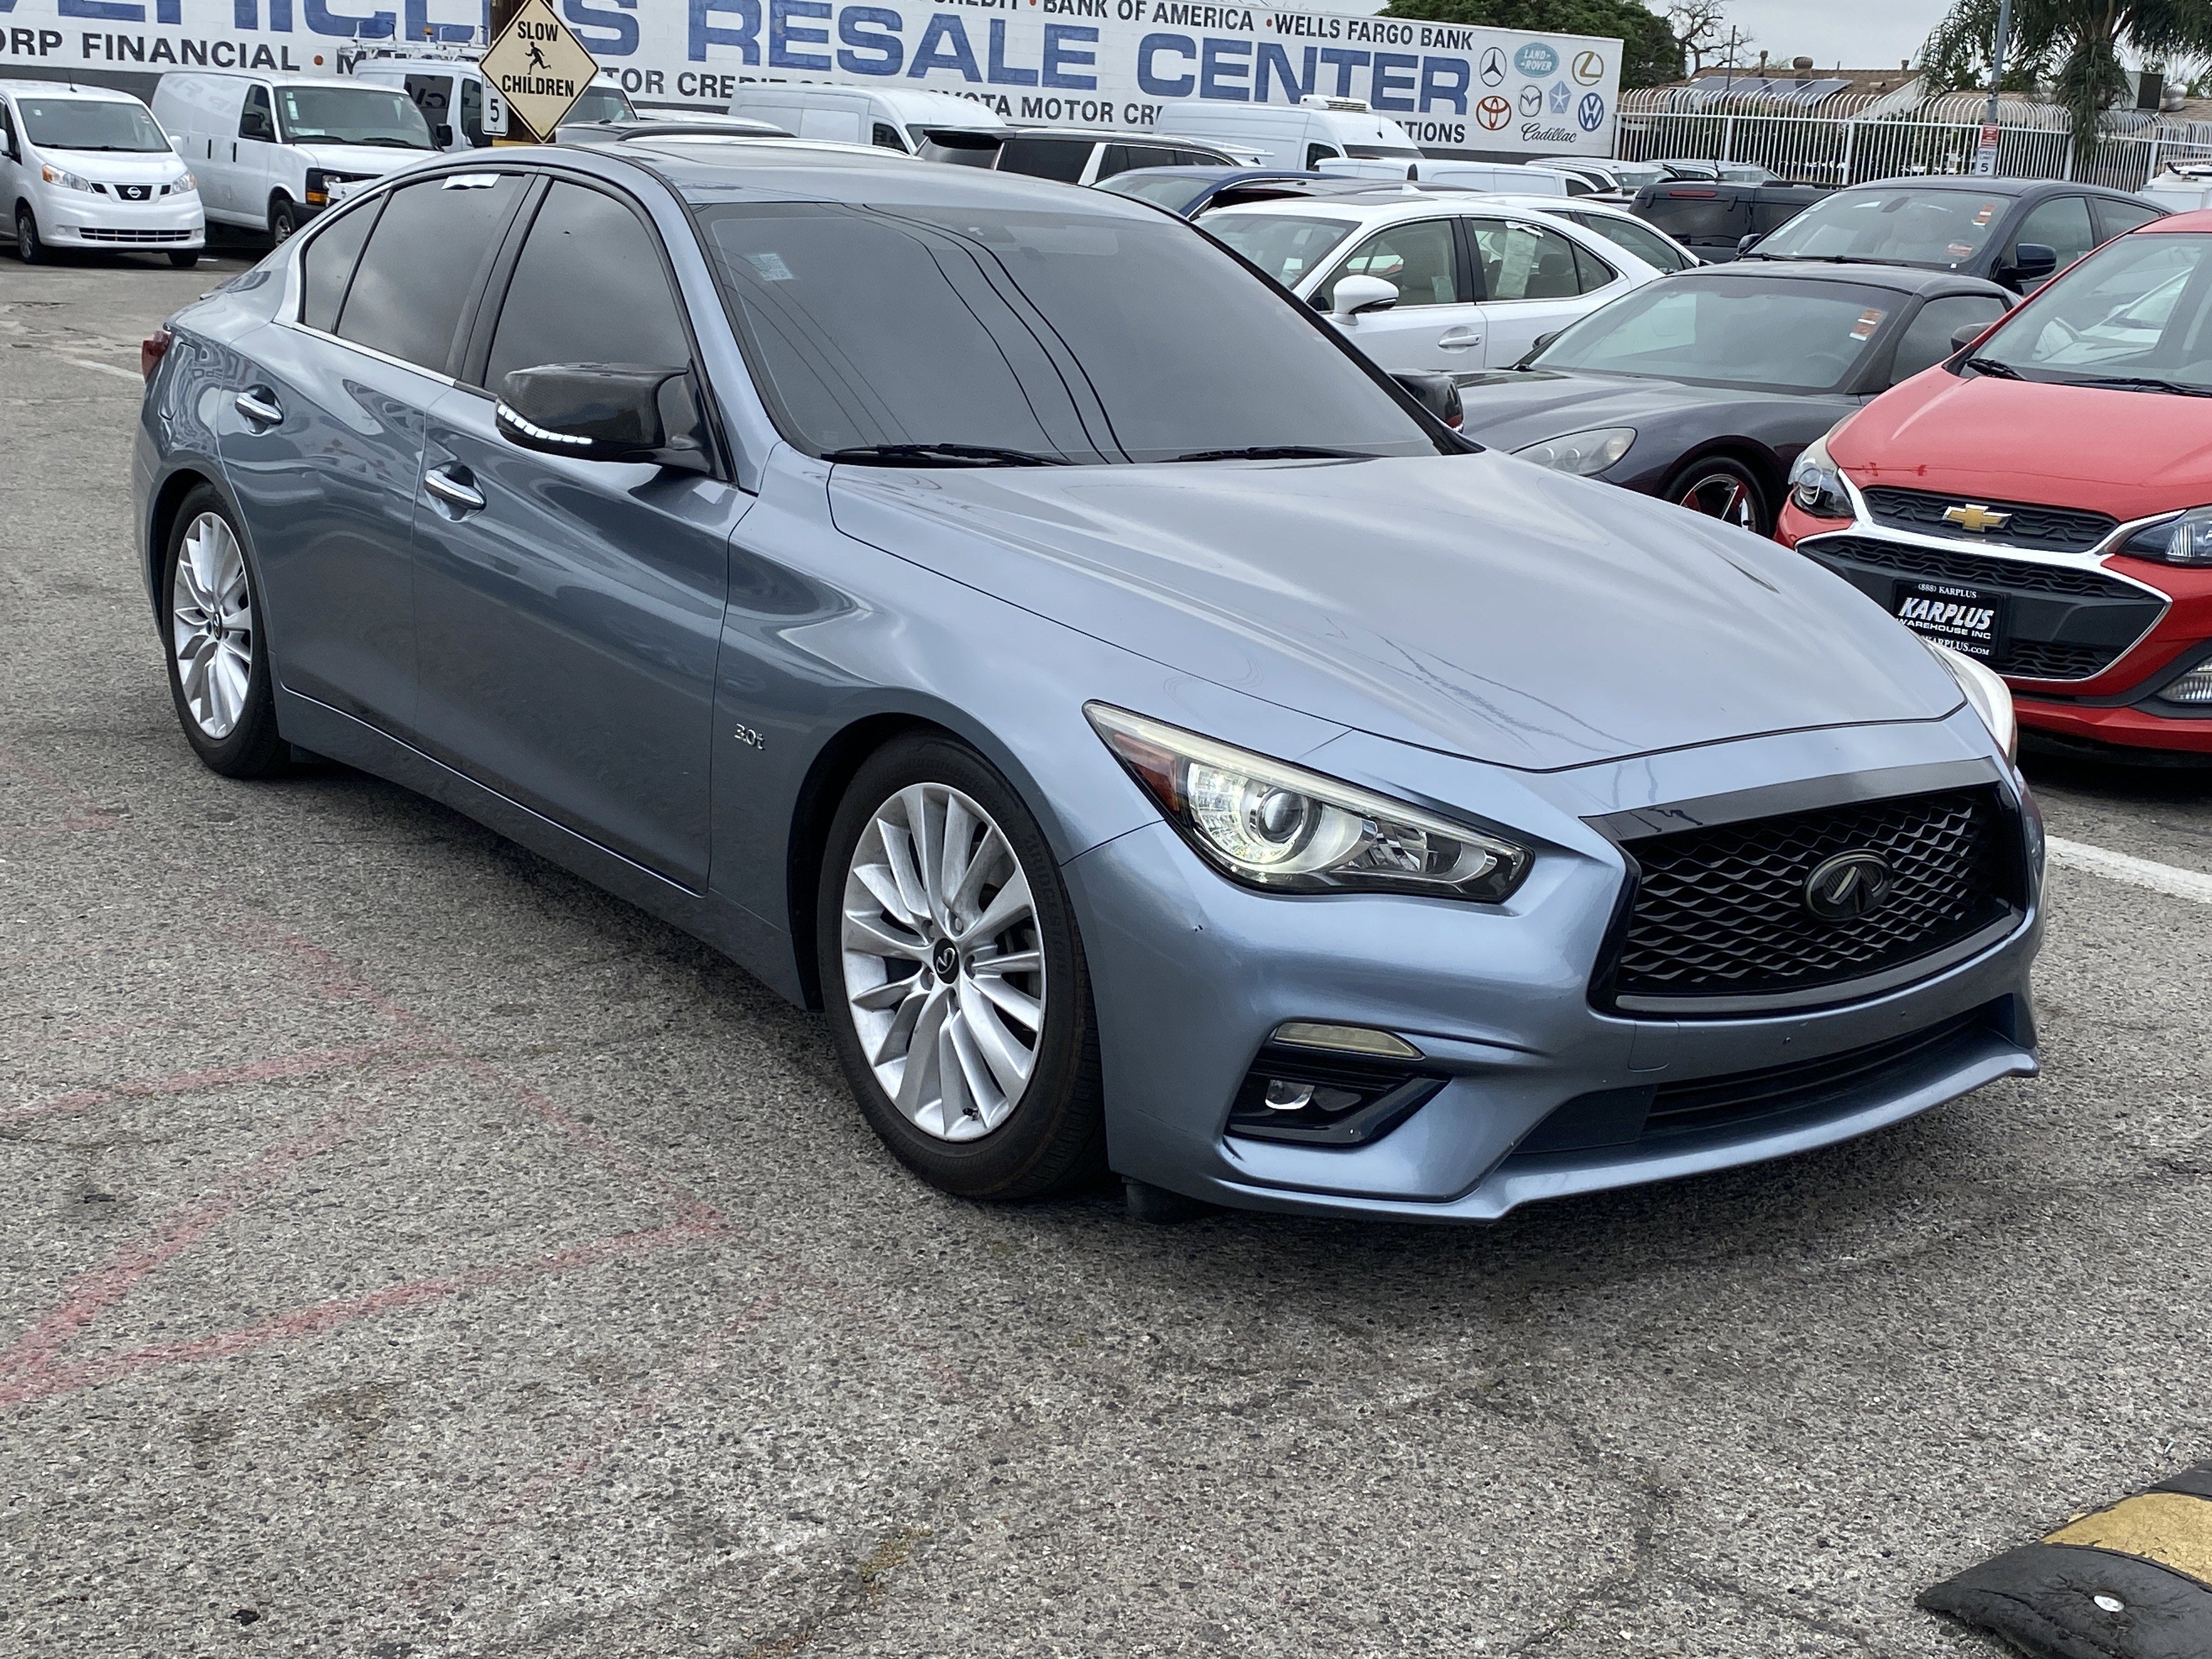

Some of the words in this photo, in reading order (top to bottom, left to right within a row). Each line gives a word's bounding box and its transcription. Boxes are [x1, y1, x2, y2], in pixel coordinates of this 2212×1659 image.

[517, 21, 558, 41] SLOW
[1043, 0, 1108, 18] BANK
[1118, 0, 1147, 21] OF
[1152, 3, 1255, 31] AMERICA
[1274, 14, 1341, 39] WELLS
[1347, 21, 1414, 44] FARGO
[1420, 28, 1474, 50] BANK
[0, 27, 63, 56] RP
[82, 32, 301, 72] FINANCIAL
[687, 0, 1099, 90] RESALE
[1137, 33, 1470, 115] CENTER
[502, 75, 574, 98] CHILDREN
[678, 72, 787, 99] CRE
[490, 99, 499, 122] 5
[1021, 97, 1114, 122] MOTOR
[1395, 121, 1465, 144] TIONS
[1521, 122, 1577, 143] Cadillac
[1980, 163, 1988, 172] 5
[1918, 584, 1937, 592] (888)
[1939, 586, 1977, 599] KARPLUS
[1898, 597, 1995, 630] KARPLUS
[1897, 618, 1968, 635] WAREHOUSE
[1971, 630, 1991, 640] INC
